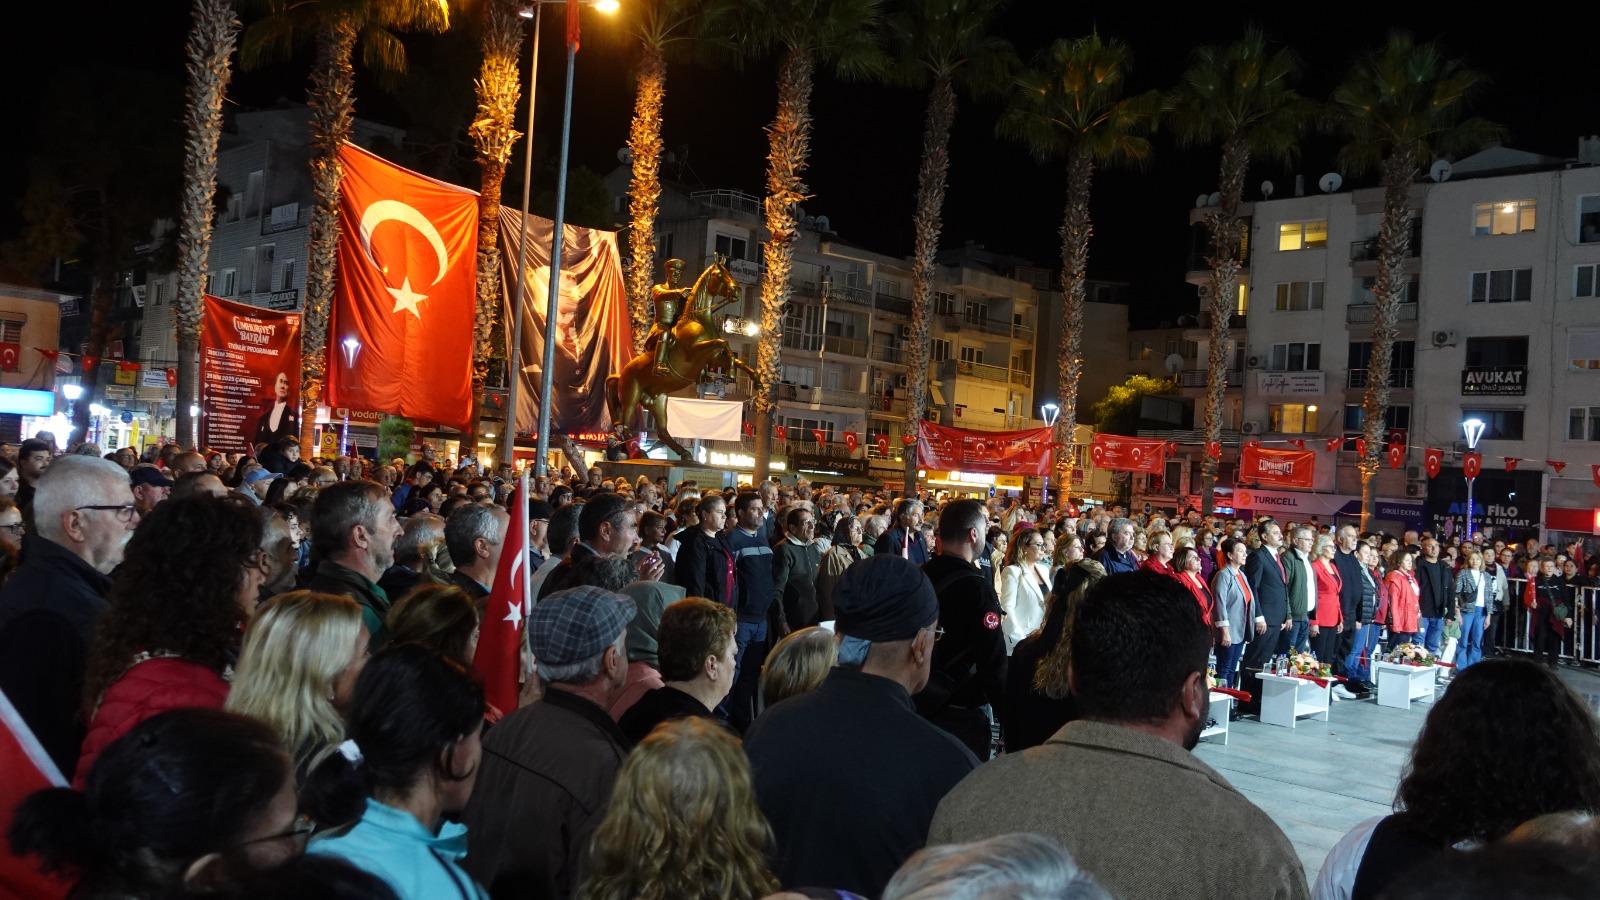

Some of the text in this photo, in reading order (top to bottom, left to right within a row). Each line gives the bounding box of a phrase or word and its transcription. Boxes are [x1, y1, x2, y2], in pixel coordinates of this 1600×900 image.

[1466, 371, 1522, 383] AVUKAT
[1254, 496, 1298, 506] TURKCELL
[1487, 504, 1518, 518] FİLO
